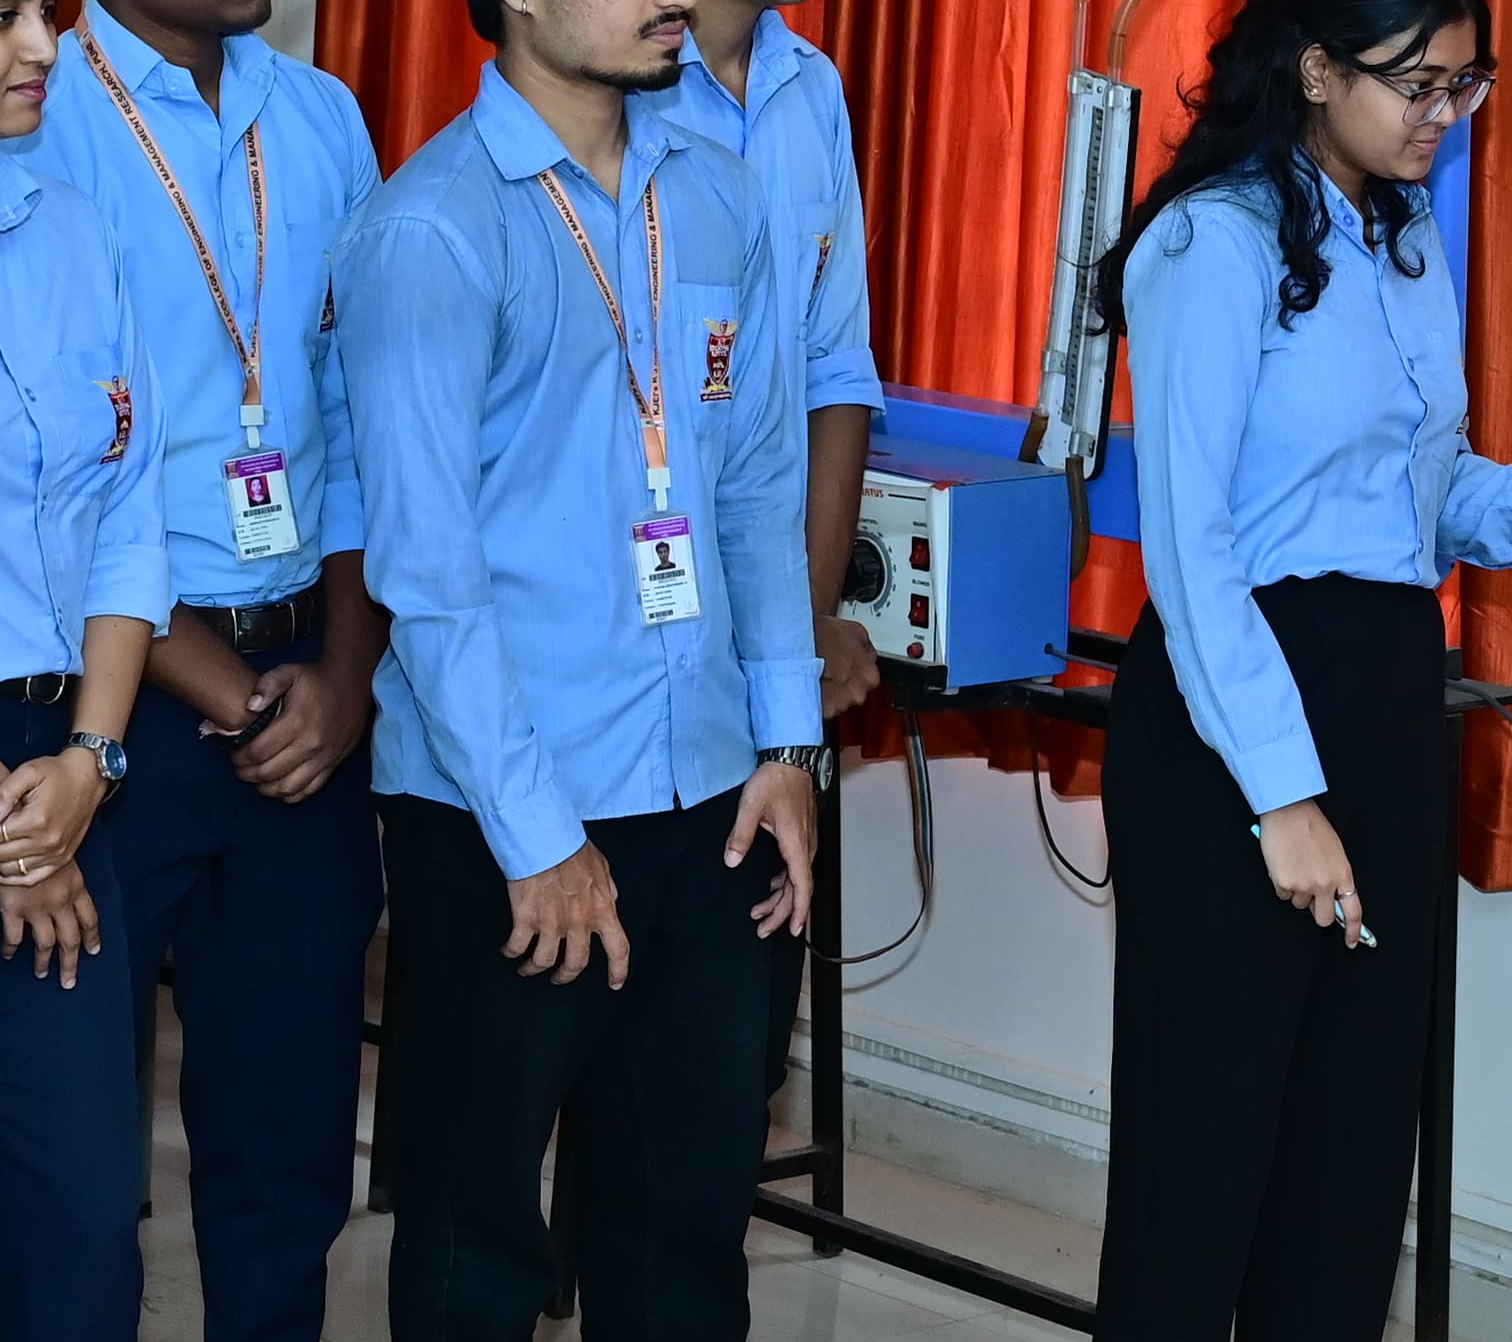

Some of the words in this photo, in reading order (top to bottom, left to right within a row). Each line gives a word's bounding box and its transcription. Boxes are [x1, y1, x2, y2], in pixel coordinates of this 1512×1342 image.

[129, 115, 171, 181] MANAGEMENT
[172, 190, 208, 257] ENGINEERING
[201, 256, 212, 271] OF
[208, 270, 231, 317] COLLEGE
[581, 242, 615, 306] ENGINEERING
[649, 234, 659, 301] ENGINEERING
